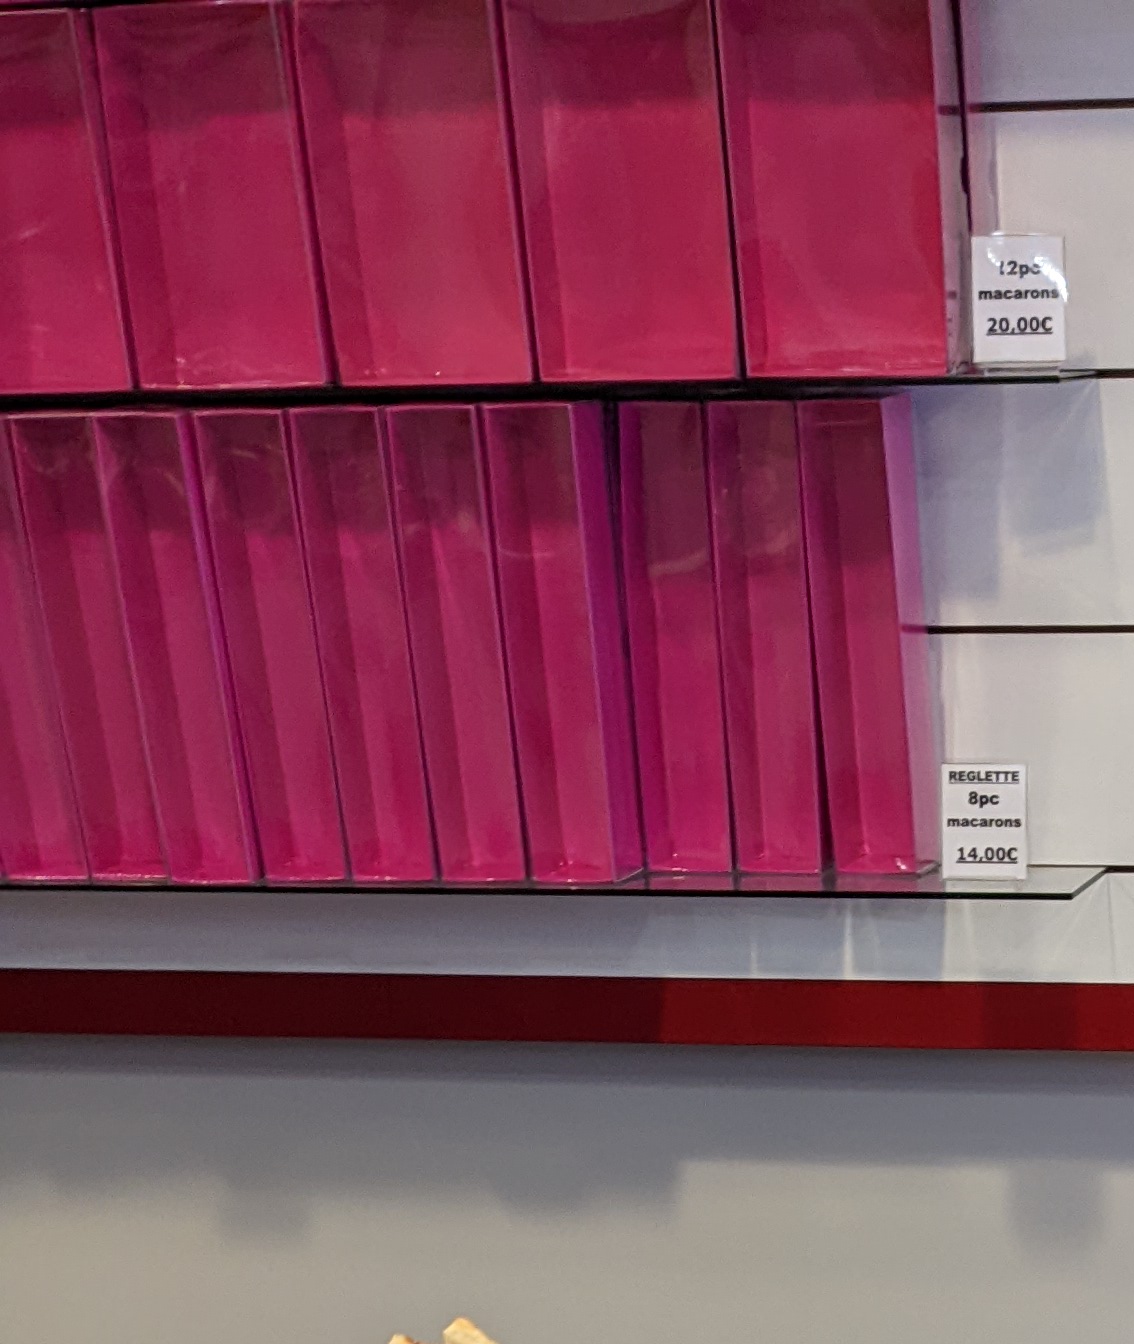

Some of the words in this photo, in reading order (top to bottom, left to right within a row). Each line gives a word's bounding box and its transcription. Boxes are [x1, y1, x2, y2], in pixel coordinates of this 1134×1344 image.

[978, 288, 1059, 300] macarons
[948, 770, 1020, 783] REGLETTE
[967, 791, 1000, 808] 8pc
[946, 817, 1022, 828] macarons
